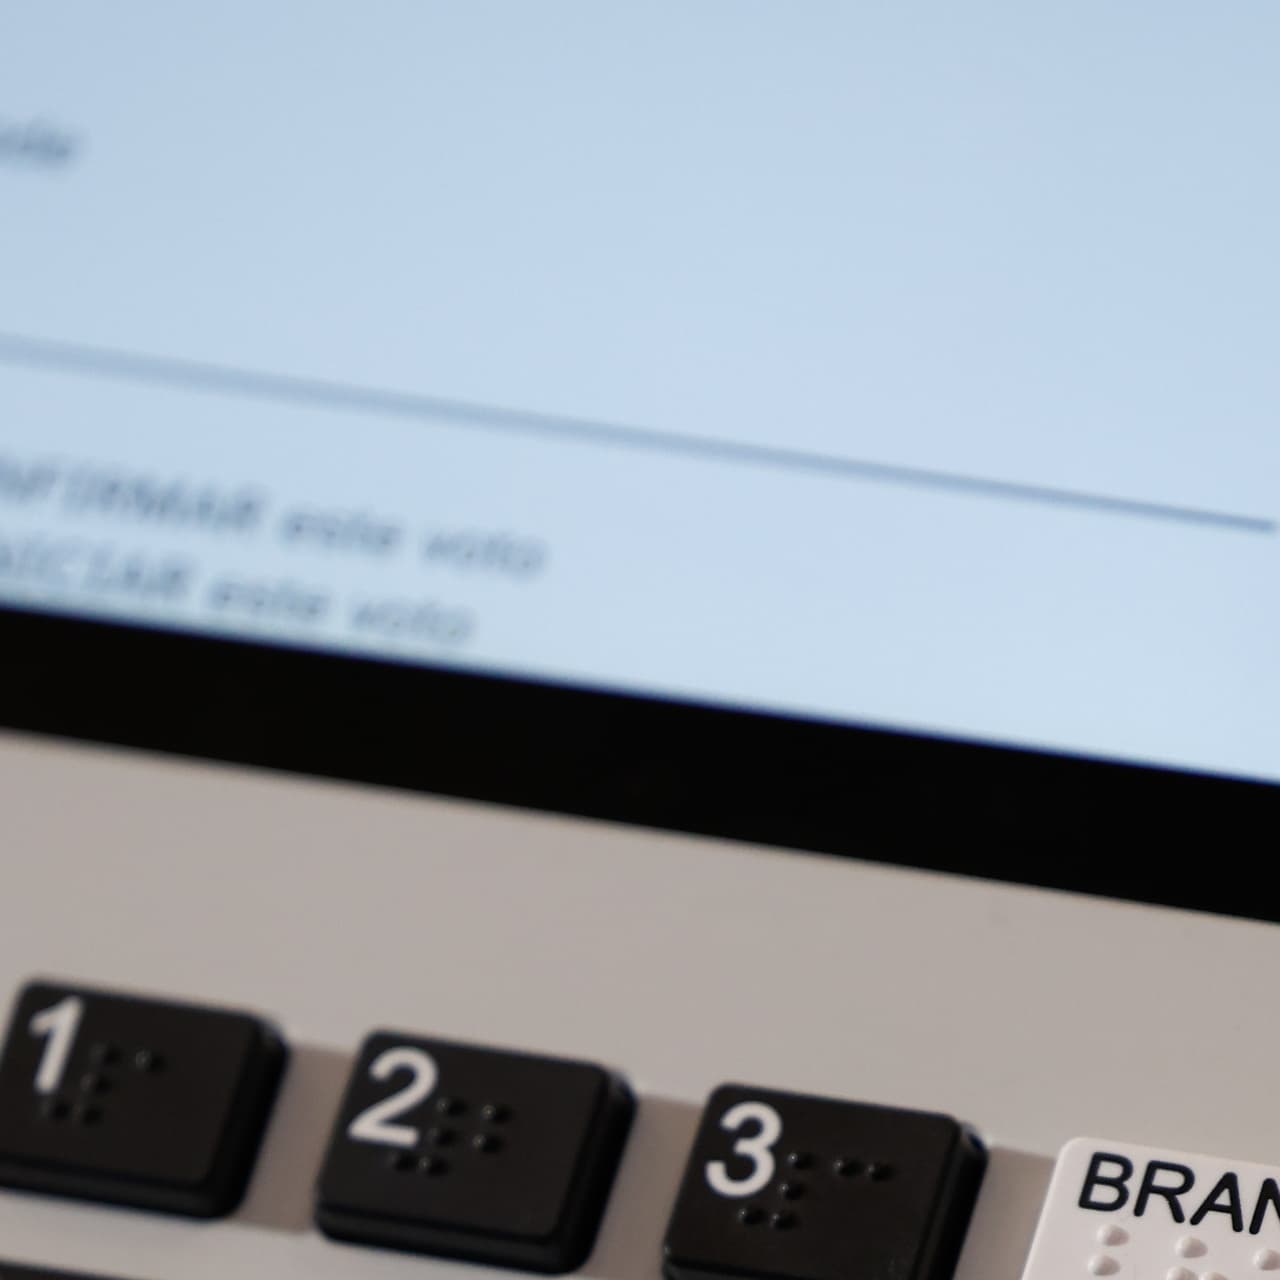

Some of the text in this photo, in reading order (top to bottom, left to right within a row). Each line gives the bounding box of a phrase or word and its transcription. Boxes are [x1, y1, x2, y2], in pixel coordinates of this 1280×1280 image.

[280, 508, 410, 562] este
[418, 526, 550, 586] voto
[204, 572, 336, 626] este
[344, 596, 480, 652] voto
[28, 995, 84, 1096] 1
[347, 1046, 438, 1148] 2
[704, 1100, 783, 1197] 3
